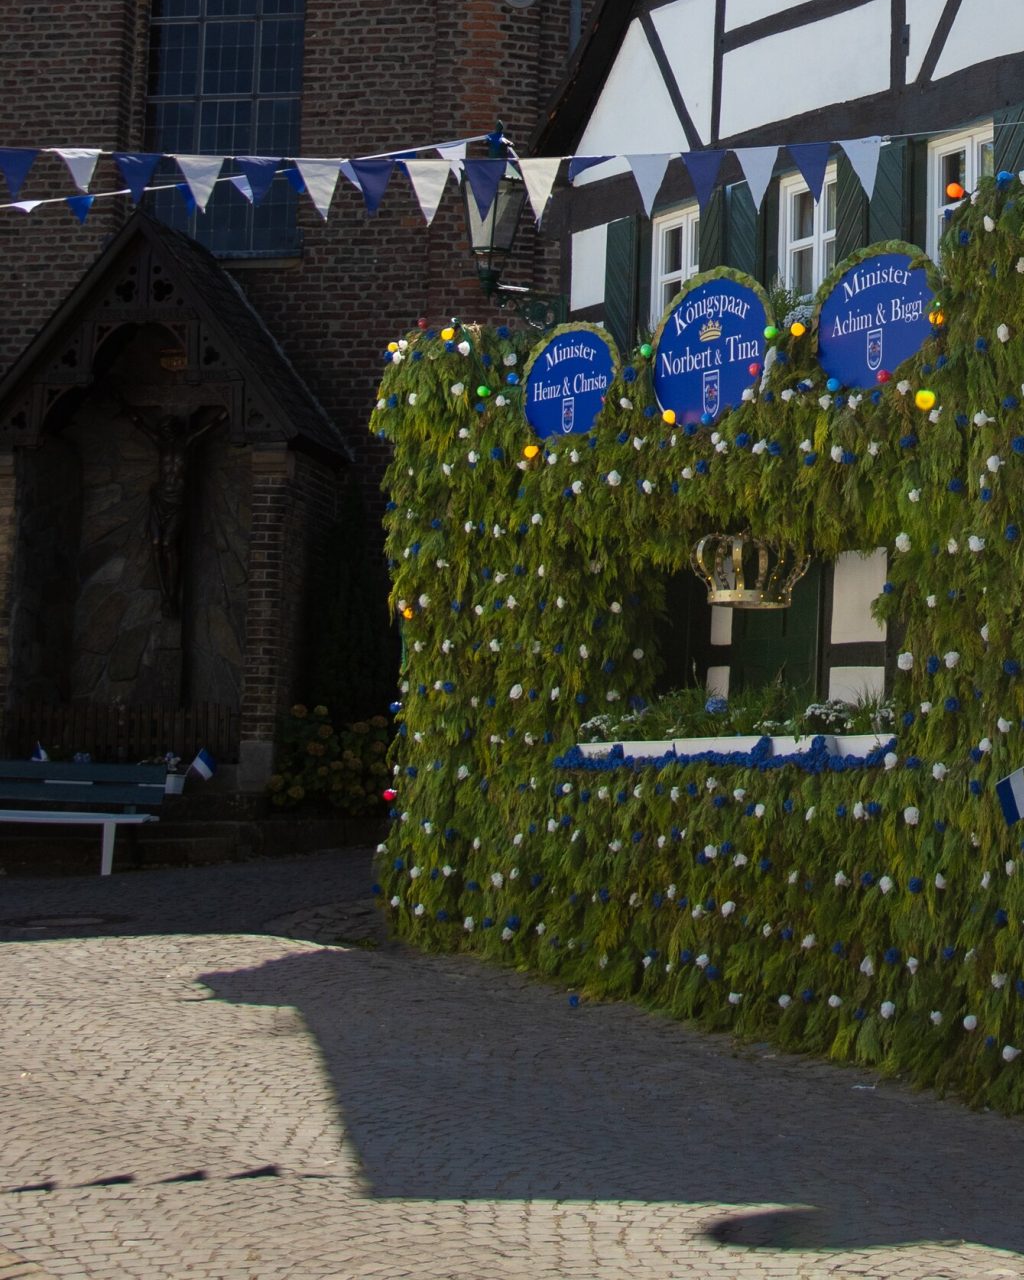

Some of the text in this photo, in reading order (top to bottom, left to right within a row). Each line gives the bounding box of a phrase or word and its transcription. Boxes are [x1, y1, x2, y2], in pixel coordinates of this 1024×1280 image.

[843, 263, 911, 303] Minister
[673, 289, 751, 336] Königspaar
[832, 291, 922, 337] Achim & Biggi
[545, 339, 597, 371] Minister
[660, 334, 759, 377] Norbert & Tina
[533, 371, 607, 402] Heinz & Christa
